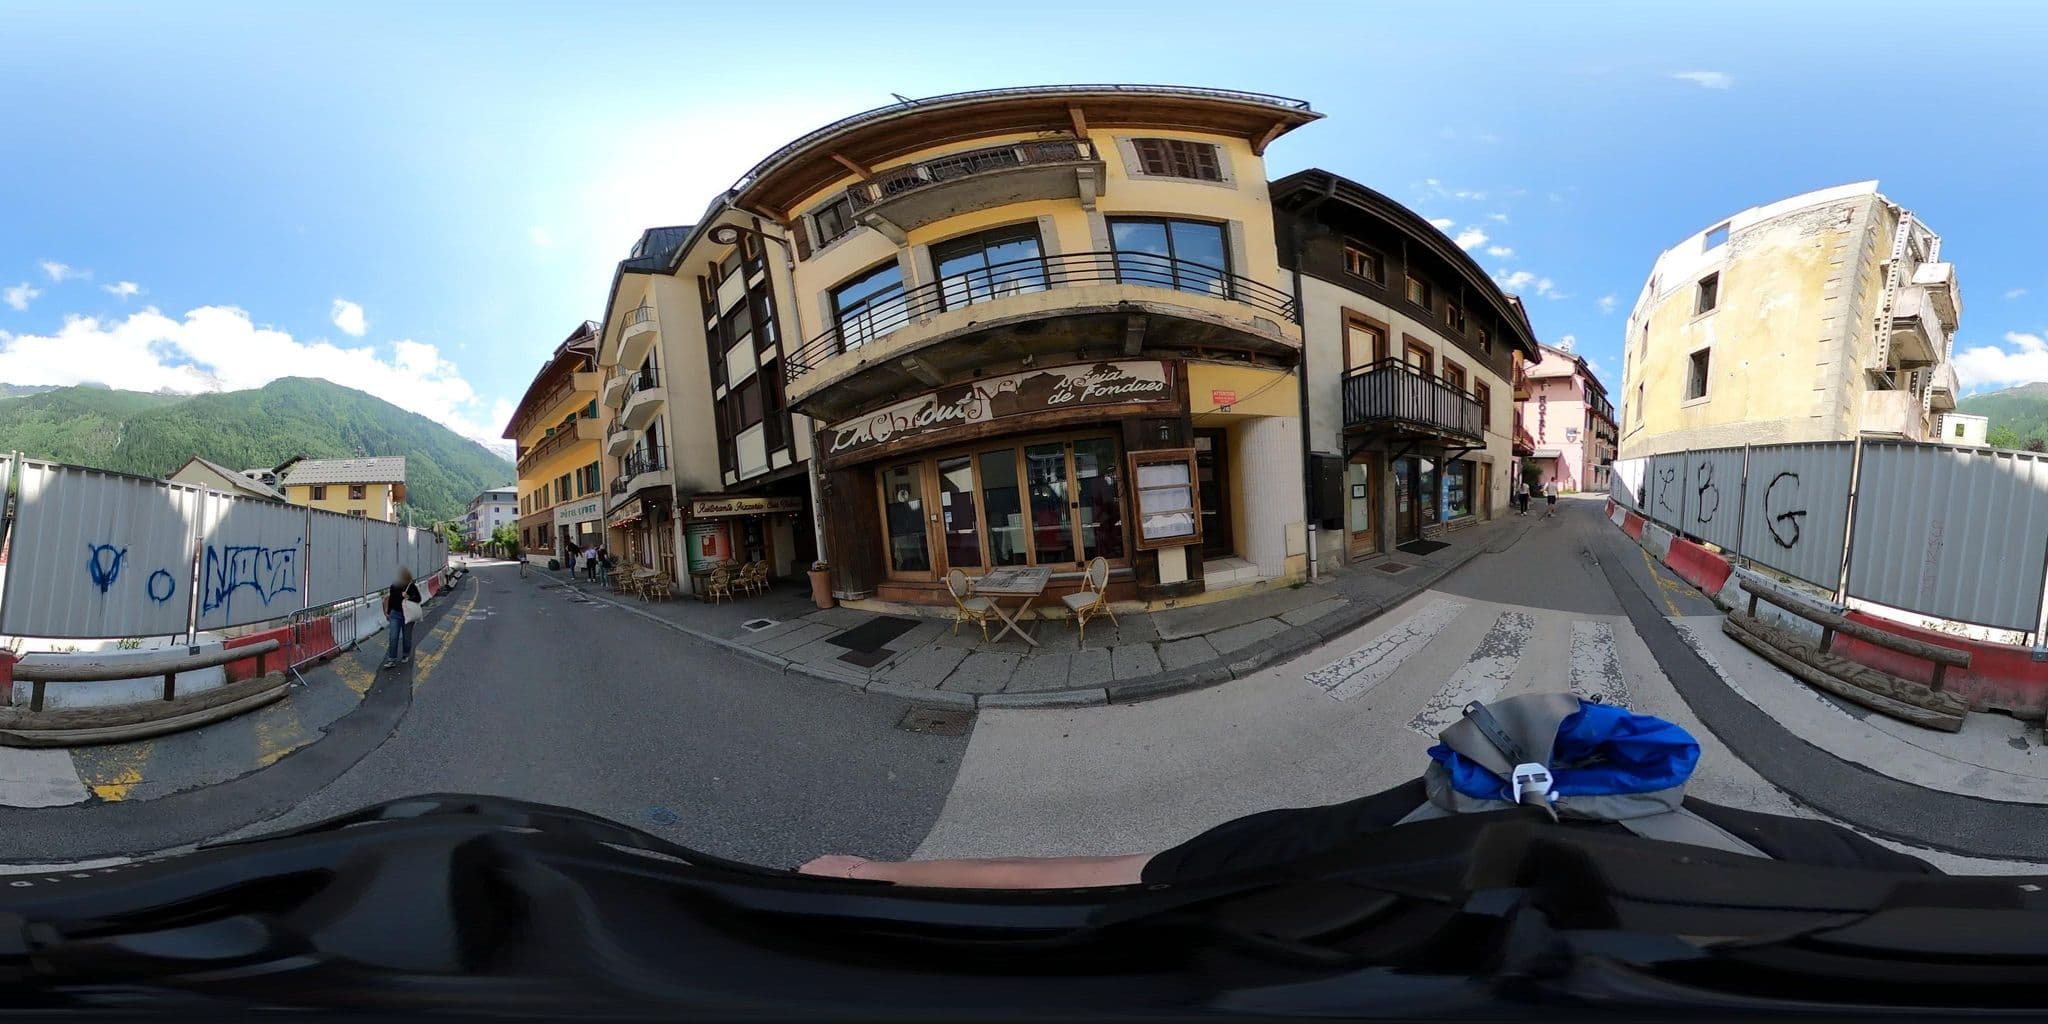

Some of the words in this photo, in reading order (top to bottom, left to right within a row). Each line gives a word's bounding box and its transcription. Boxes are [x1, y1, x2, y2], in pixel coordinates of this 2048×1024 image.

[1048, 389, 1075, 405] de
[1080, 379, 1164, 403] Fondues
[1538, 395, 1547, 436] HOTEL
[1764, 471, 1807, 549] G
